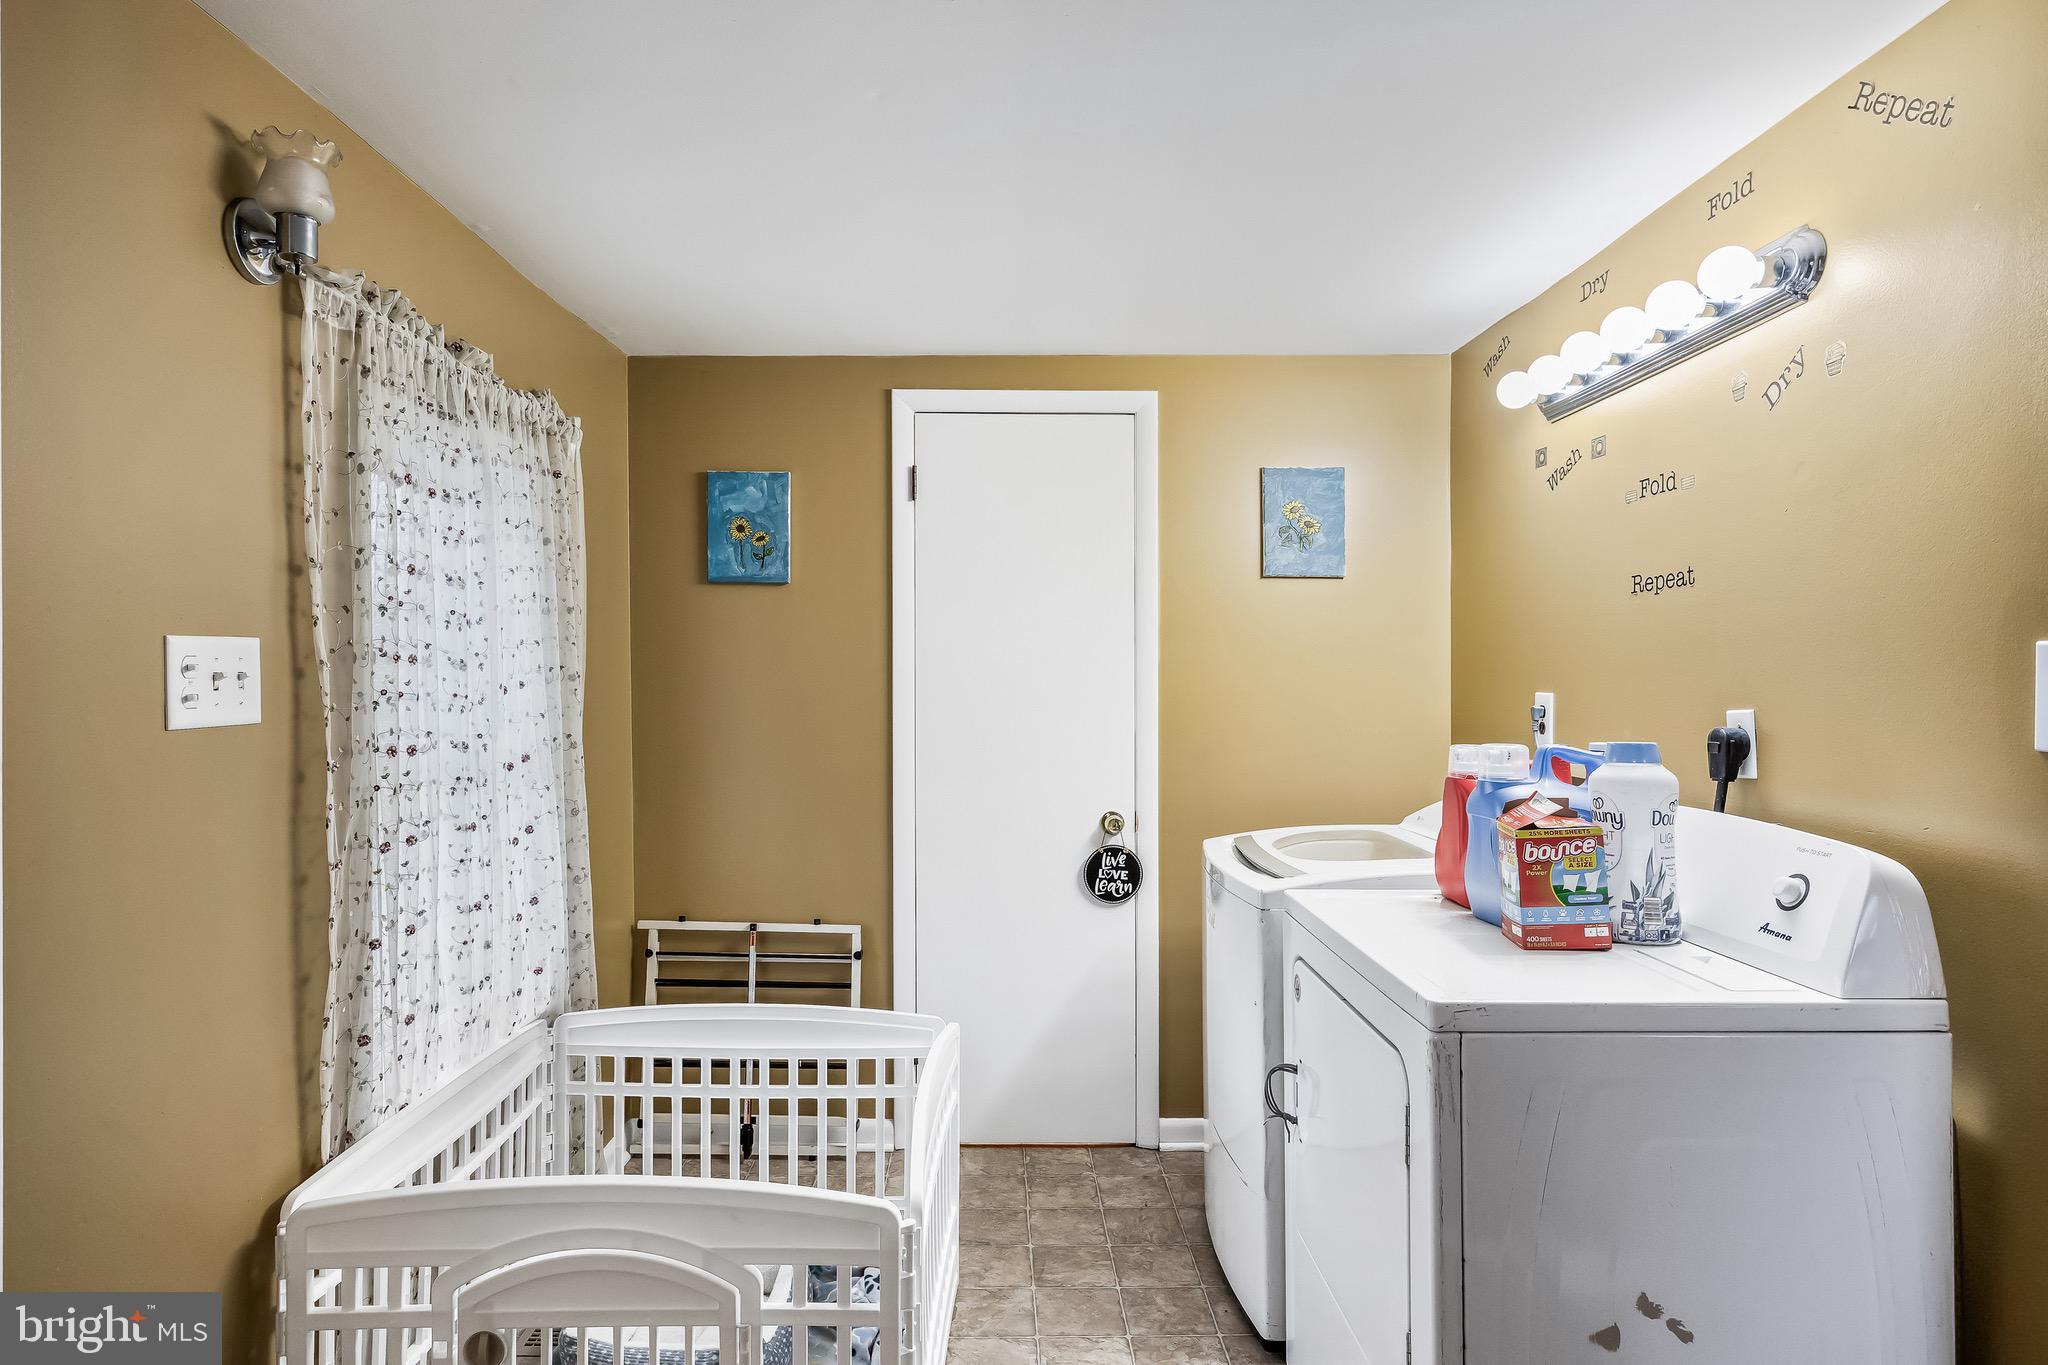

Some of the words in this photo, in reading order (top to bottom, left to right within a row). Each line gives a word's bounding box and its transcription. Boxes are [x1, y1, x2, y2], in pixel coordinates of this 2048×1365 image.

[1847, 80, 1956, 128] Repeat
[1706, 171, 1755, 221] Fold
[1579, 269, 1611, 303] Dry
[1482, 334, 1511, 379] Wash
[1761, 343, 1805, 412] Dry
[1546, 447, 1583, 492] Wash
[1638, 470, 1678, 499] Fold
[1630, 565, 1696, 596] Repeat
[1101, 851, 1127, 869] Live
[1523, 837, 1597, 863] bounce
[1094, 878, 1133, 897] Learn
[1526, 935, 1540, 943] 400
[1758, 922, 1793, 942] Amana
